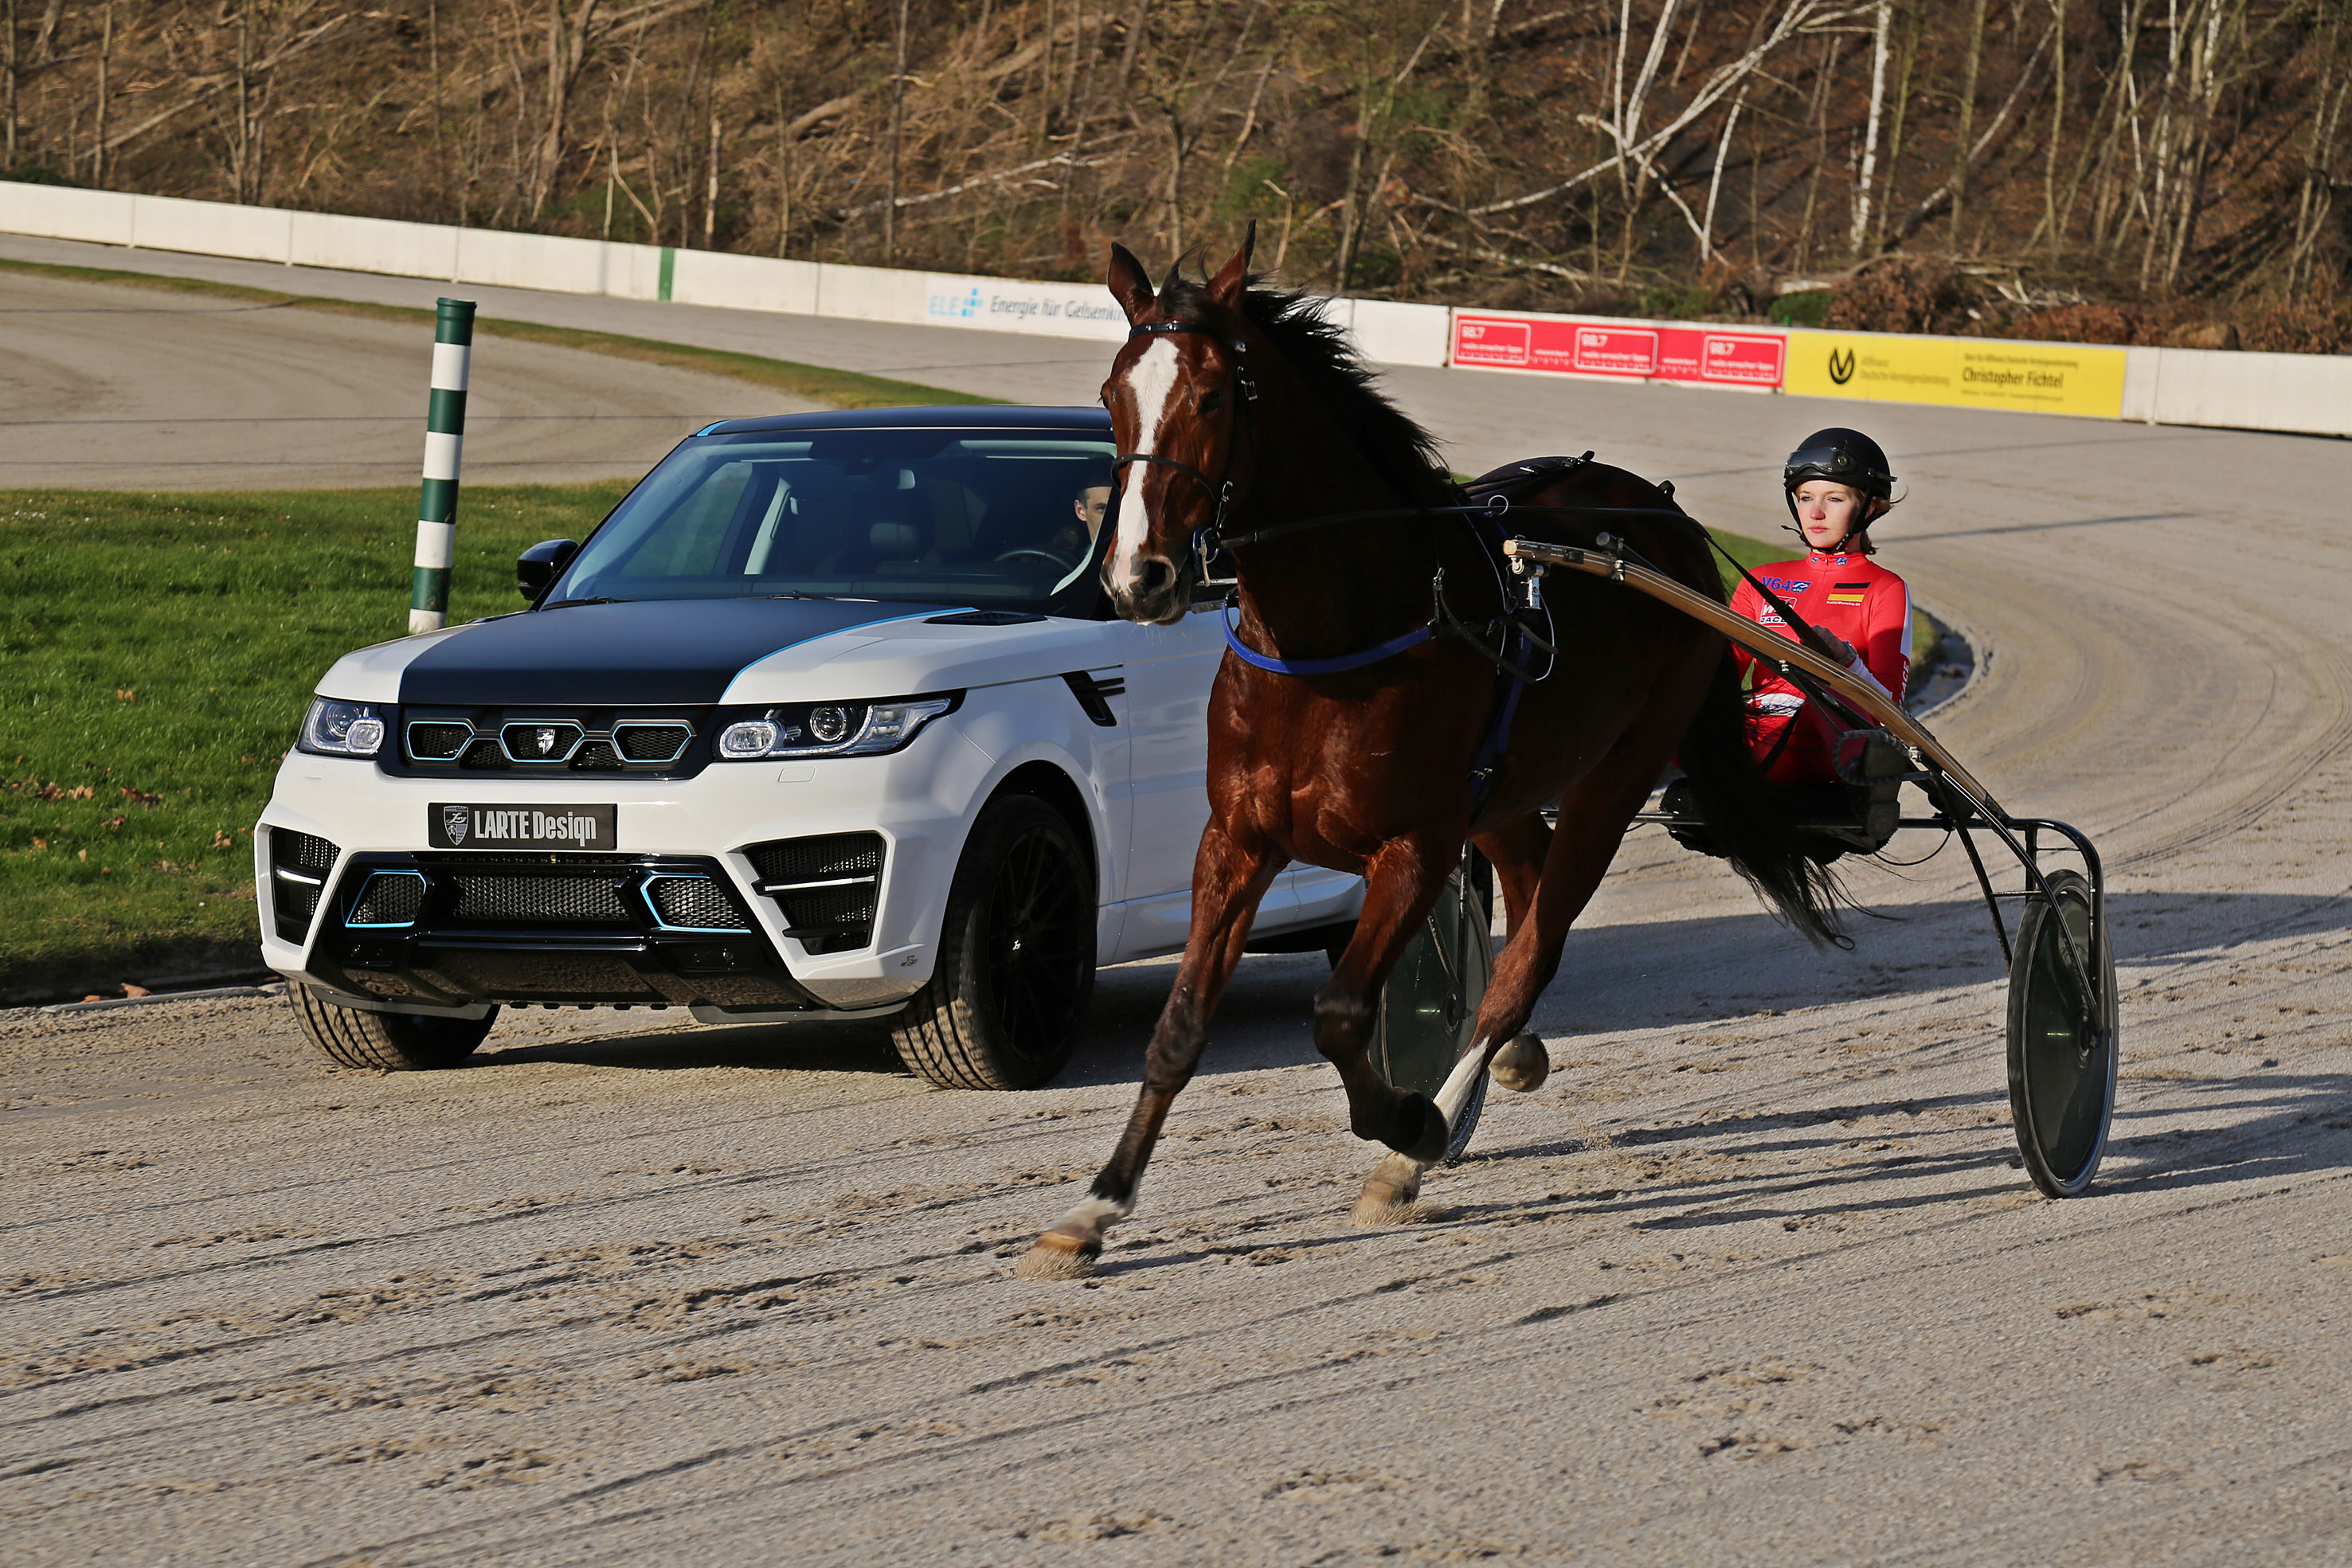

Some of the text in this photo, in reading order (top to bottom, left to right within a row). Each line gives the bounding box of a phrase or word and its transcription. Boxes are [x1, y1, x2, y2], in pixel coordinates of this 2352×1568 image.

[990, 295, 1037, 319] Energie
[1041, 298, 1063, 317] für
[1963, 366, 2064, 388] Christopher Fichtel
[1762, 576, 1792, 592] V64
[474, 810, 597, 847] LARTE Design
